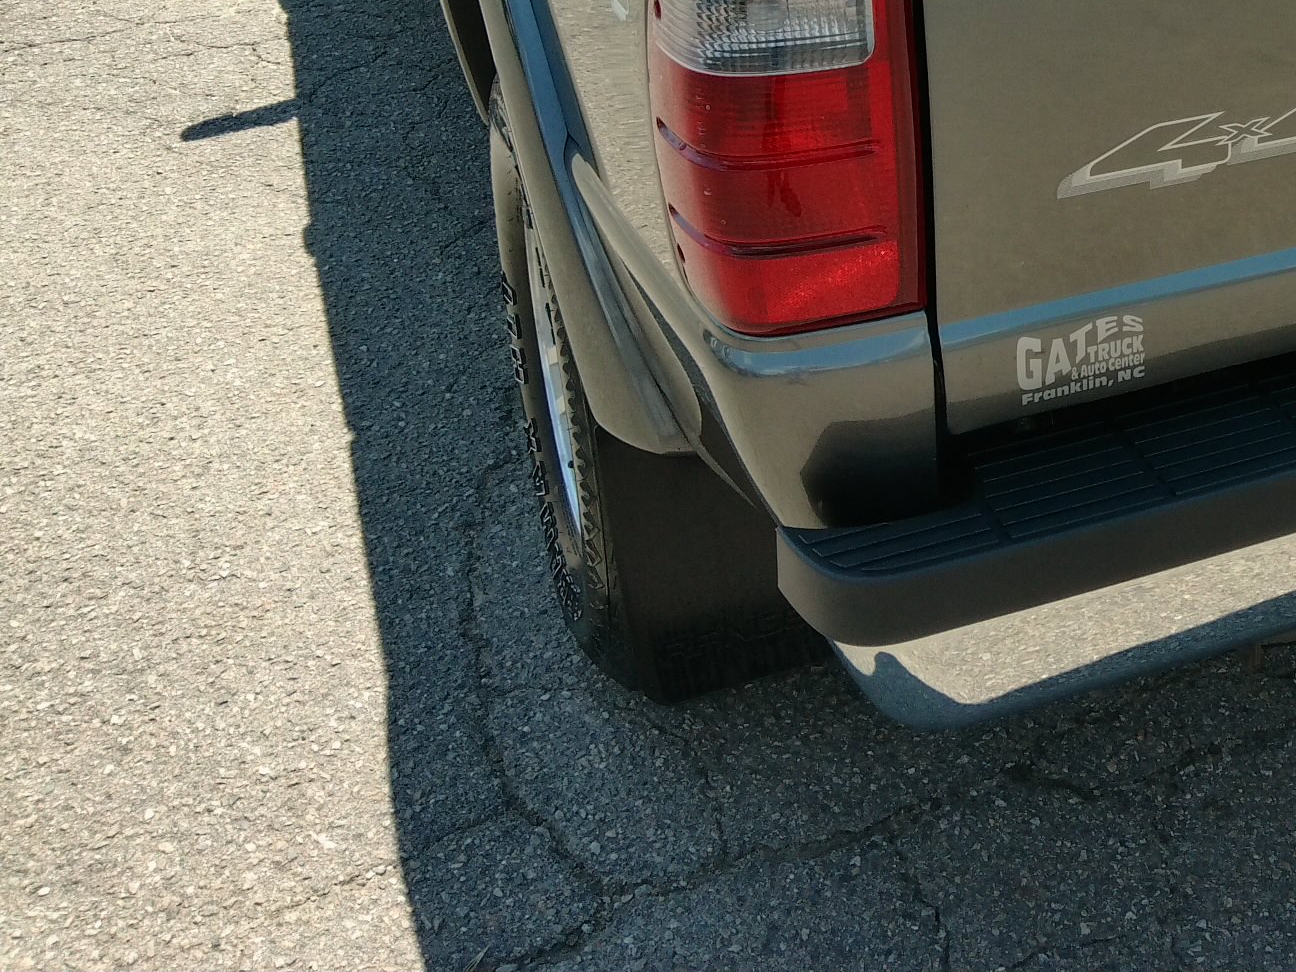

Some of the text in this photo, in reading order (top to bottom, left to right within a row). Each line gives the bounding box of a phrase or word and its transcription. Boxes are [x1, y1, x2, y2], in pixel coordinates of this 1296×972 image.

[1016, 314, 1144, 390] GATES
[1087, 334, 1144, 363] TRUCK
[1021, 366, 1146, 406] Franklin, NC
[1071, 367, 1079, 380] &
[1080, 359, 1107, 378] Auto
